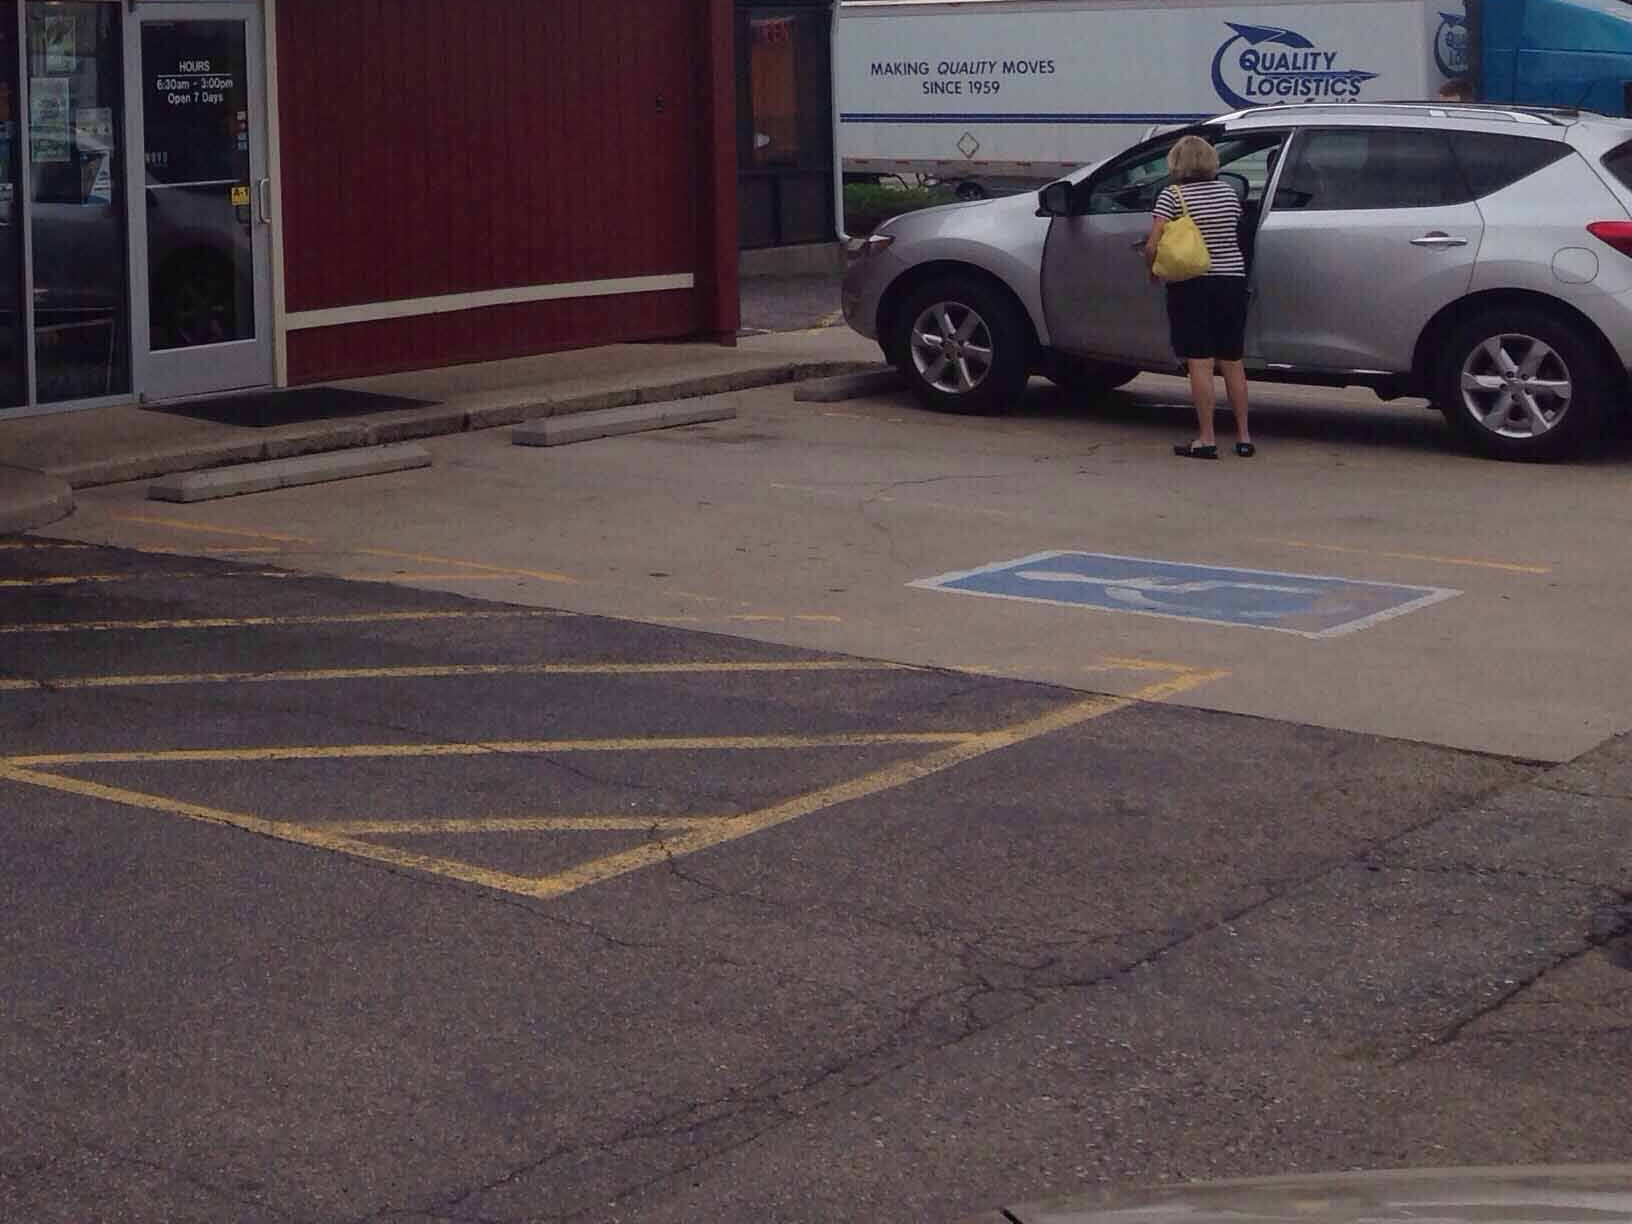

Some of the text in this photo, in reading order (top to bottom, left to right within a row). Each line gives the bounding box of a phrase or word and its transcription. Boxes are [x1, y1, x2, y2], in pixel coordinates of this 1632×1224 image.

[179, 60, 210, 72] HOURS
[1239, 48, 1337, 73] QUALITY
[871, 60, 1055, 76] MAKING QUALITY MOVES
[156, 78, 190, 90] 6:30am
[200, 77, 233, 90] 3:00pm
[922, 80, 1000, 94] SINCE 1959
[1246, 75, 1361, 96] LOGISTICS
[167, 92, 224, 105] Open 7 Days
